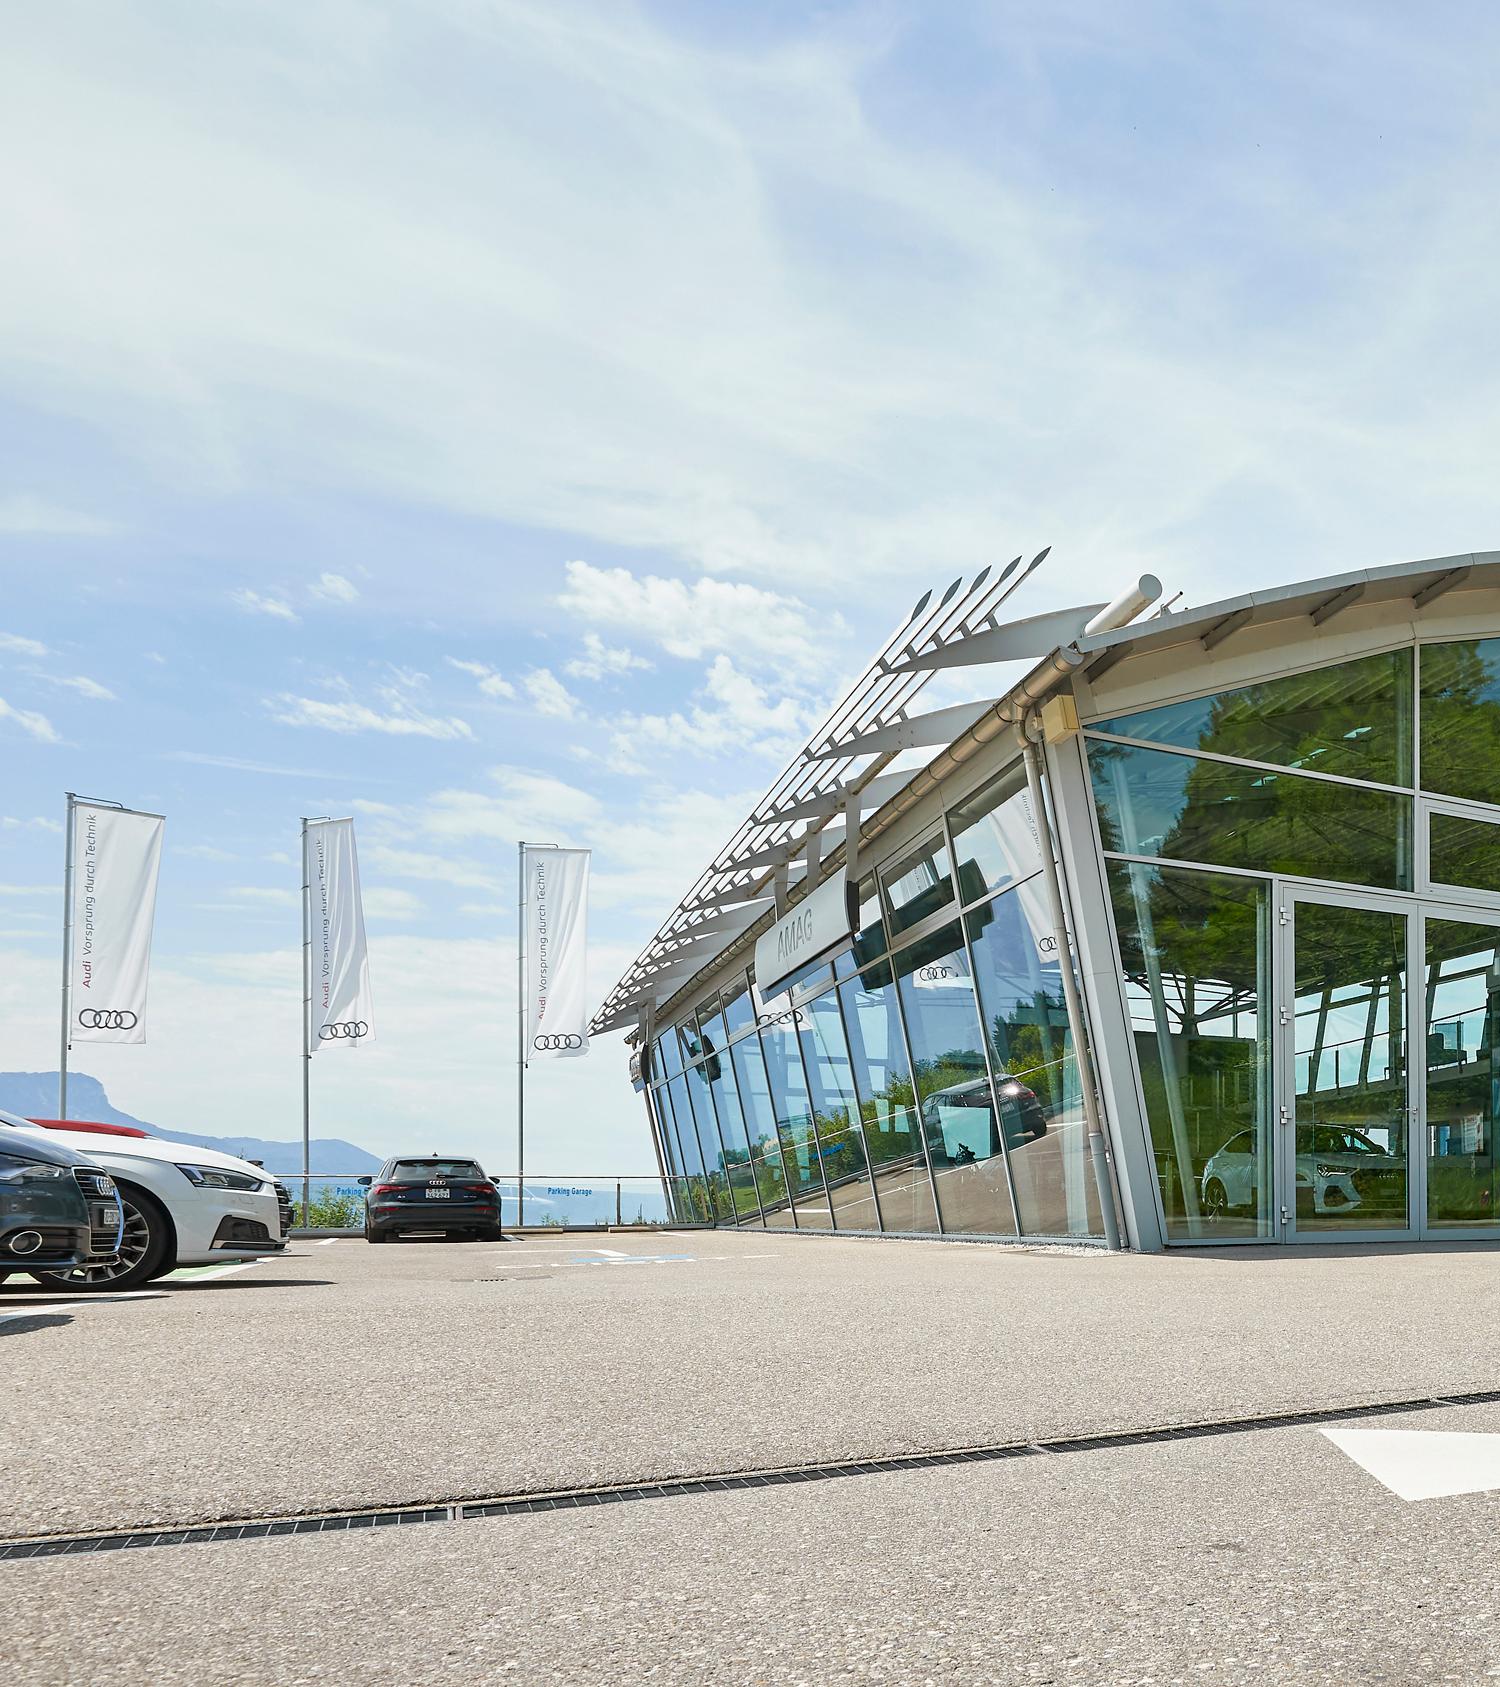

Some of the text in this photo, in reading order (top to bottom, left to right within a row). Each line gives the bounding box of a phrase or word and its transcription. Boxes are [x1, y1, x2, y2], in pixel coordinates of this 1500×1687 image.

[316, 839, 326, 881] Technik
[82, 814, 97, 988] Audi Vorsprung durch Technik
[321, 919, 330, 978] Vorsprung
[536, 861, 549, 1020] Audi Vorsprung durch Technik
[777, 908, 812, 962] AMAG
[336, 1187, 362, 1196] Parking
[547, 1187, 593, 1197] Parking Garage
